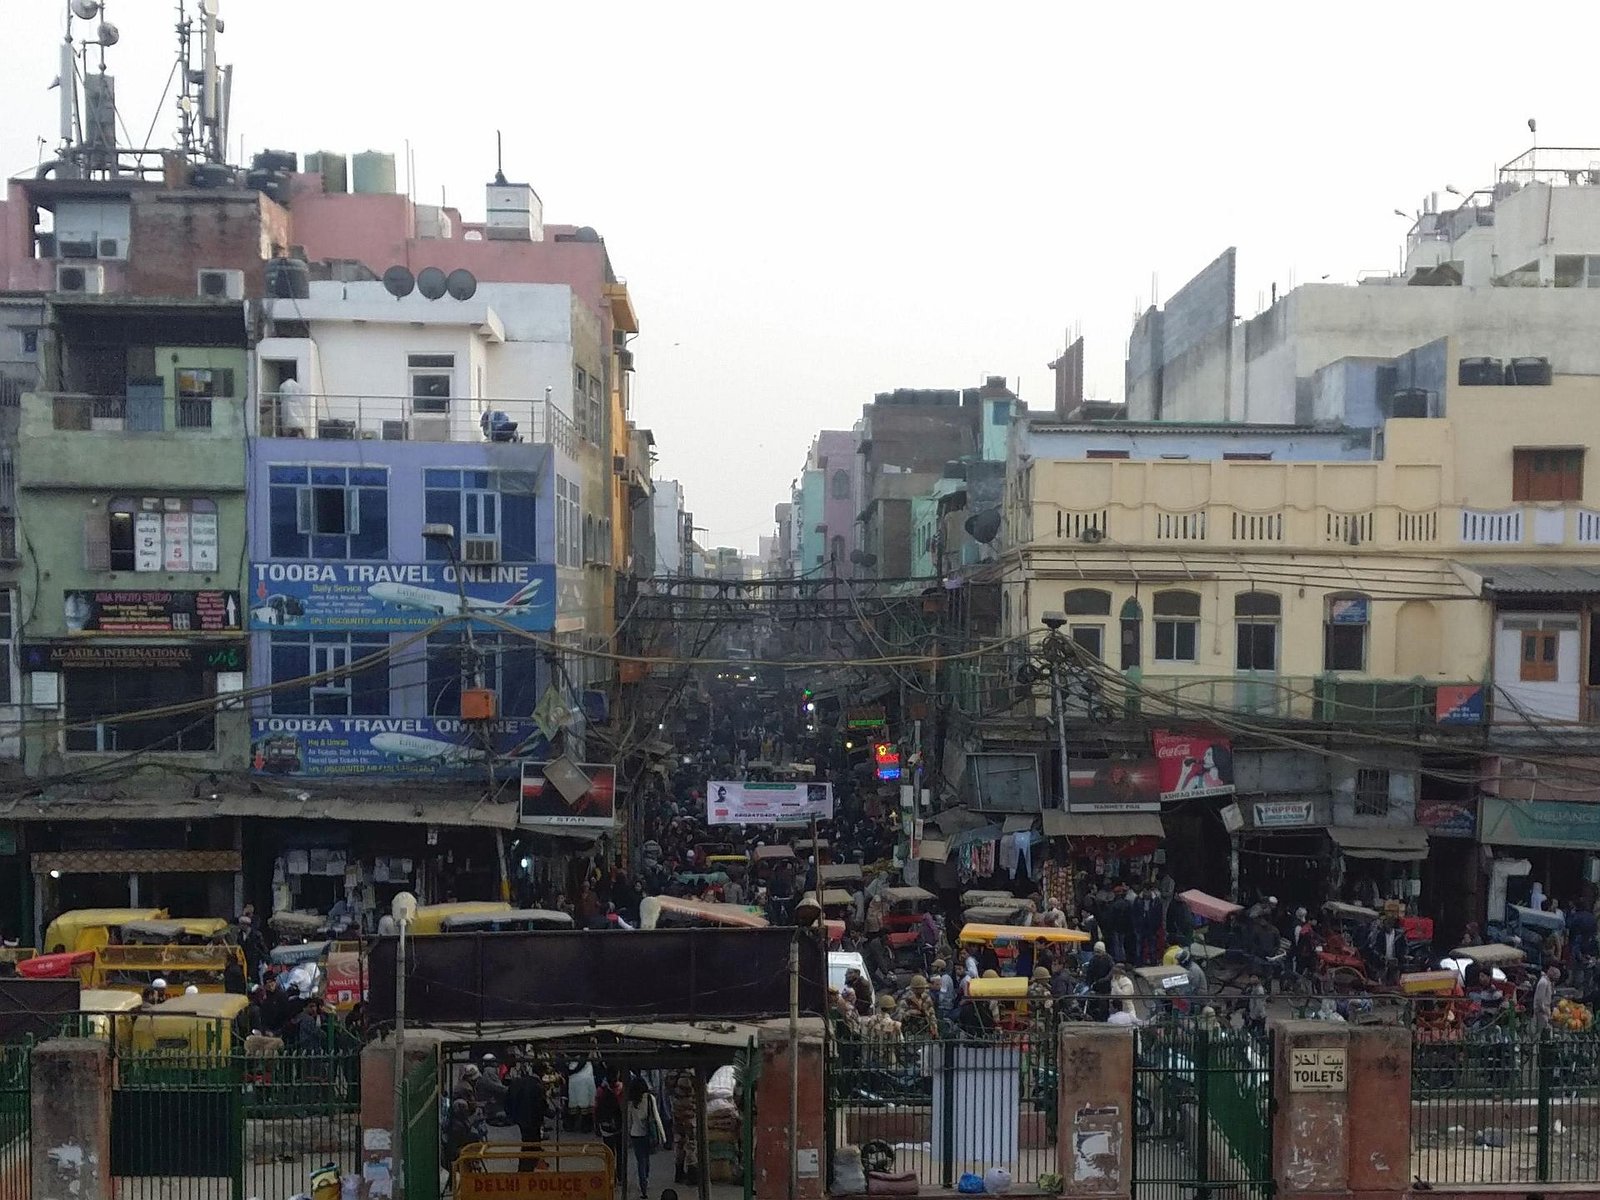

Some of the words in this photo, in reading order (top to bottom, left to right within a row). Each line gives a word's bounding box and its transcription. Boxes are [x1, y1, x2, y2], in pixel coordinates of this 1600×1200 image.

[254, 564, 337, 582] TOOBA
[344, 565, 435, 582] TRAVEL
[443, 566, 529, 583] ONLINE
[334, 584, 362, 592] Service
[103, 648, 192, 658] INTERNATIONAL
[255, 719, 334, 732] TOOBA
[341, 719, 428, 732] TRAVEL
[1163, 792, 1190, 801] ASHFAQ
[1191, 789, 1205, 797] PAN
[1206, 786, 1234, 796] CORNER
[1294, 1071, 1344, 1082] TOILETS
[474, 1178, 520, 1192] DELHI
[528, 1177, 582, 1192] POLICE
